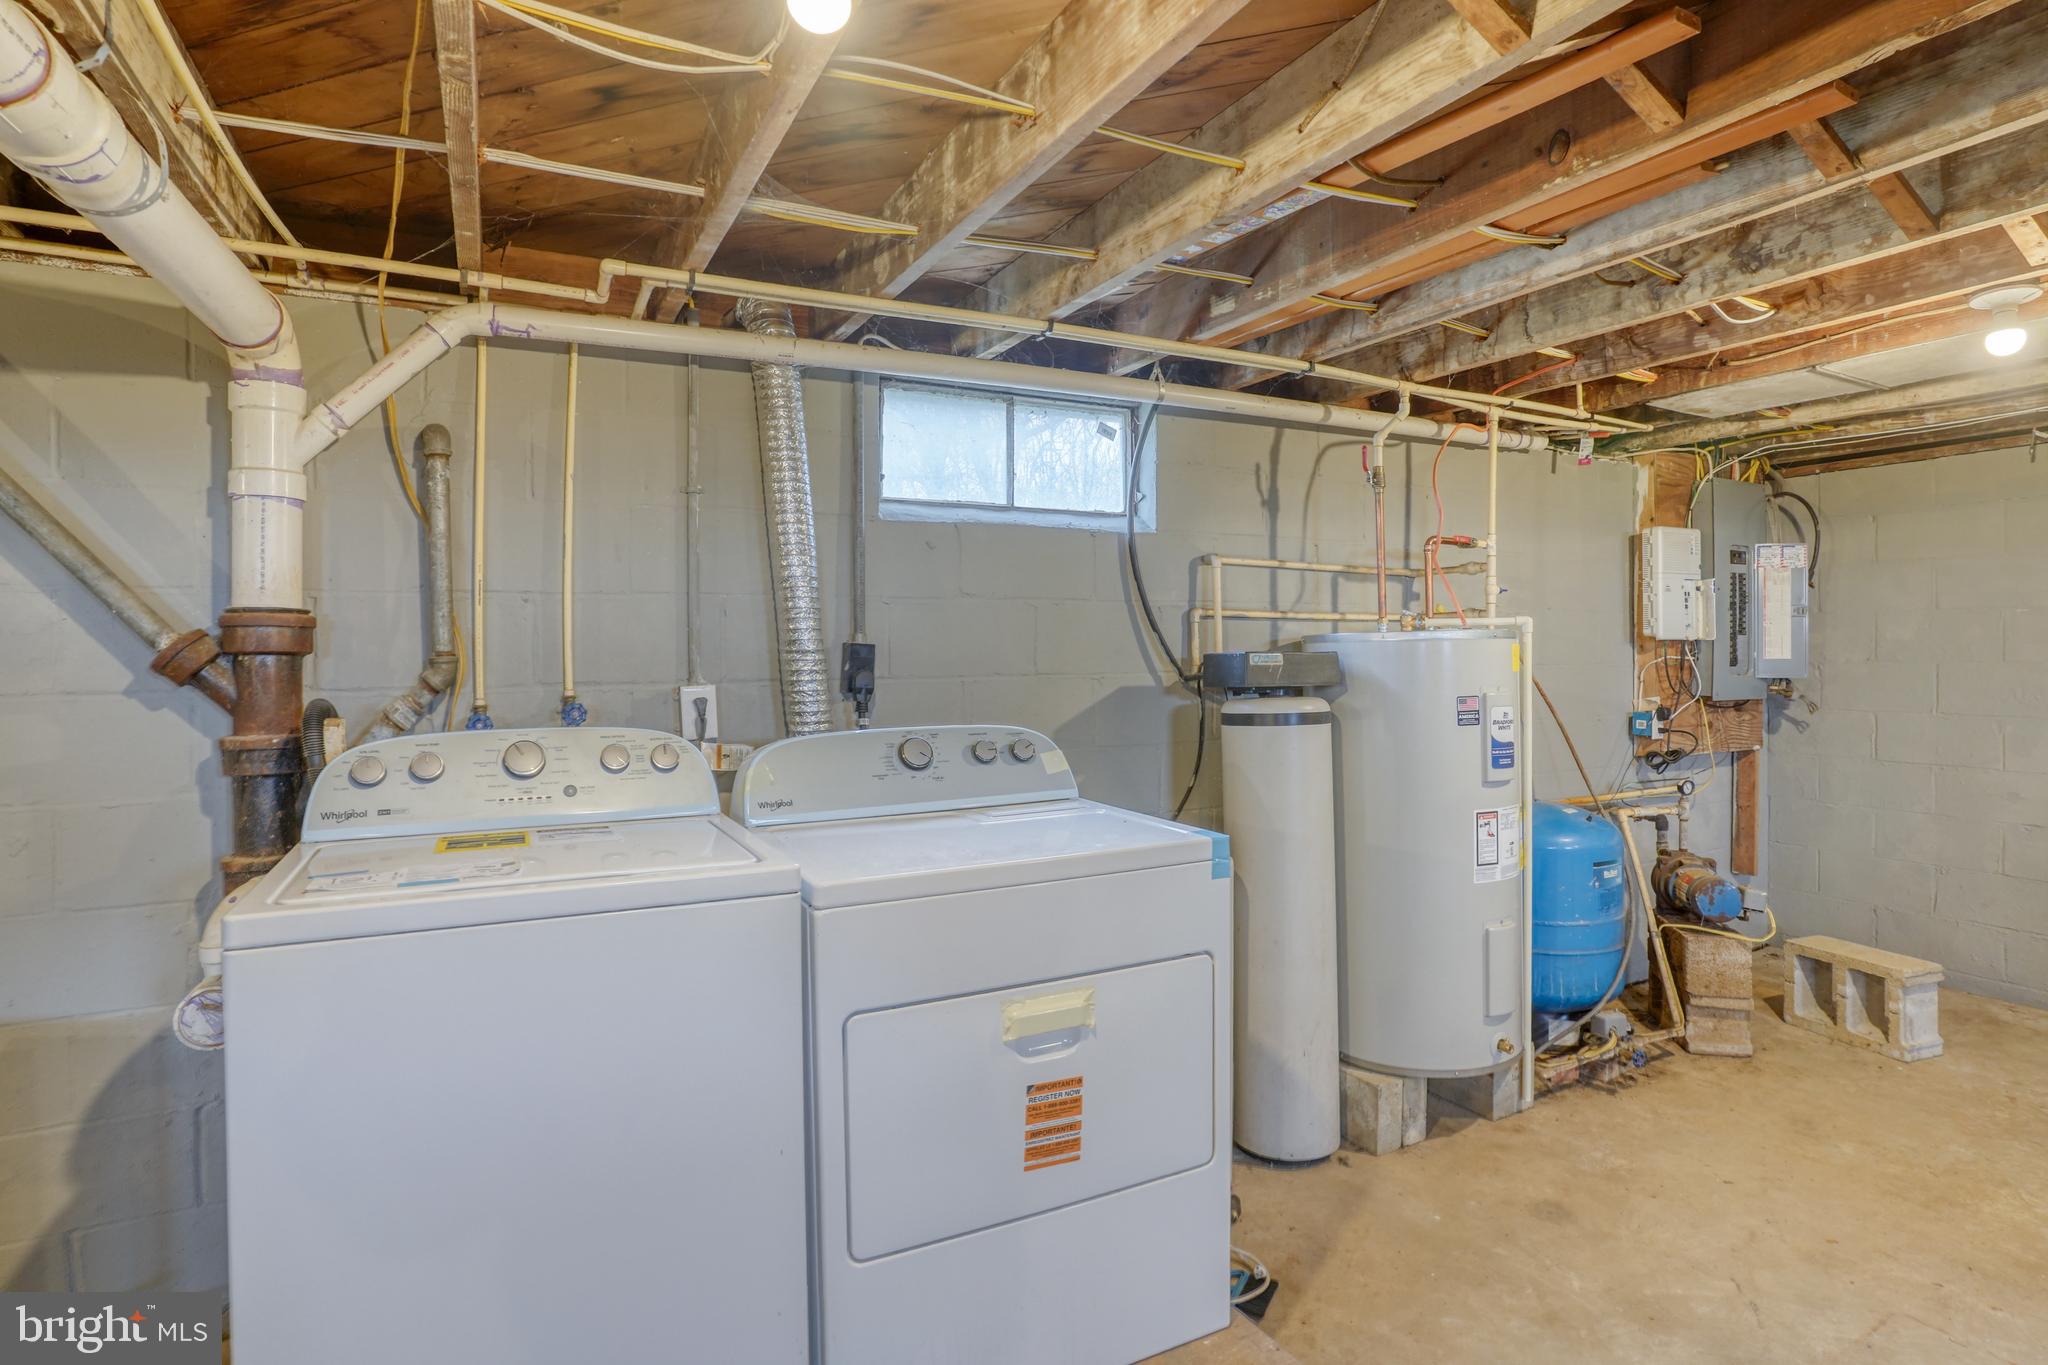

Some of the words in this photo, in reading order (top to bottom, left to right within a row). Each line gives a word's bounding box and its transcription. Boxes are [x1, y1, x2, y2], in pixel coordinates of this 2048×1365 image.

[757, 799, 793, 812] Whirlpool
[320, 808, 368, 824] Whirlpool
[1028, 1092, 1063, 1104] REGISTER
[1064, 1089, 1081, 1097] NOW
